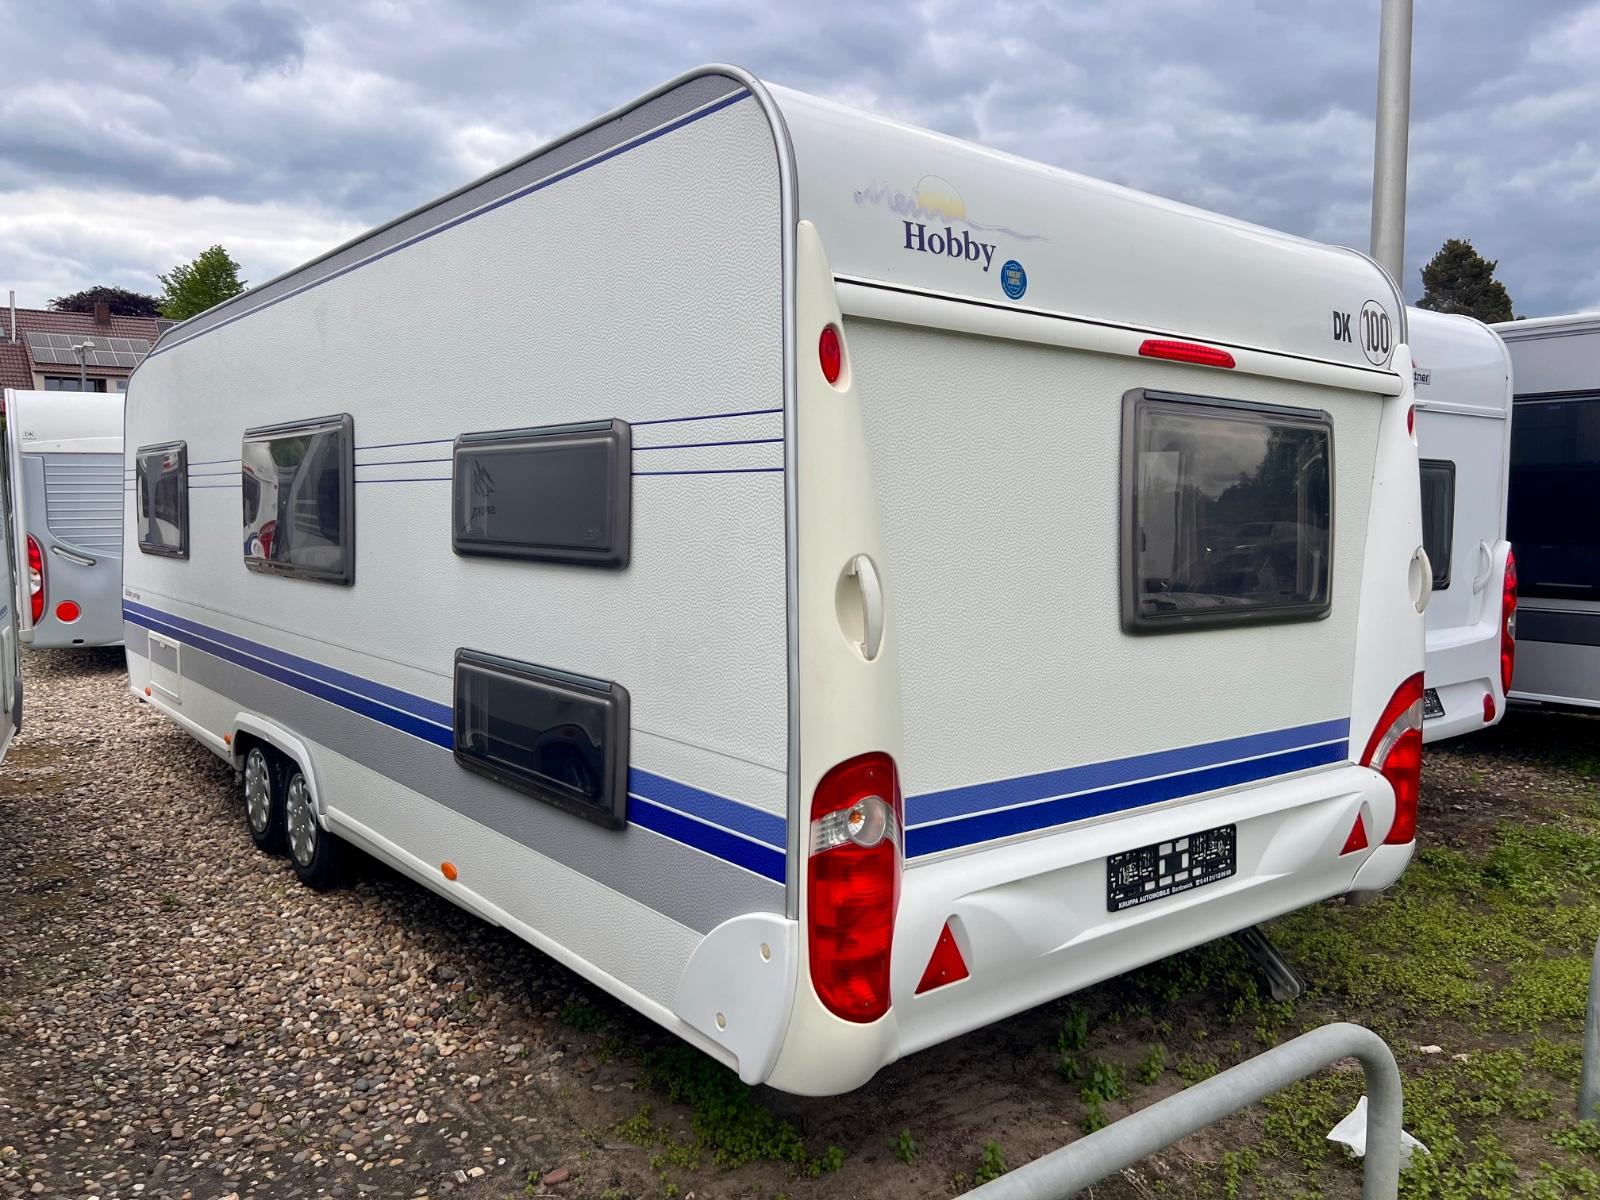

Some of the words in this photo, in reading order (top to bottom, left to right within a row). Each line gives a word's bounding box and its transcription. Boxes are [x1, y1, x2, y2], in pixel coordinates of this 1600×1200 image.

[902, 219, 997, 272] Hobby
[1333, 310, 1352, 343] DK
[1363, 308, 1389, 354] 100
[1118, 897, 1139, 909] KRUPPA
[1140, 888, 1171, 903] AUTOMOBILE
